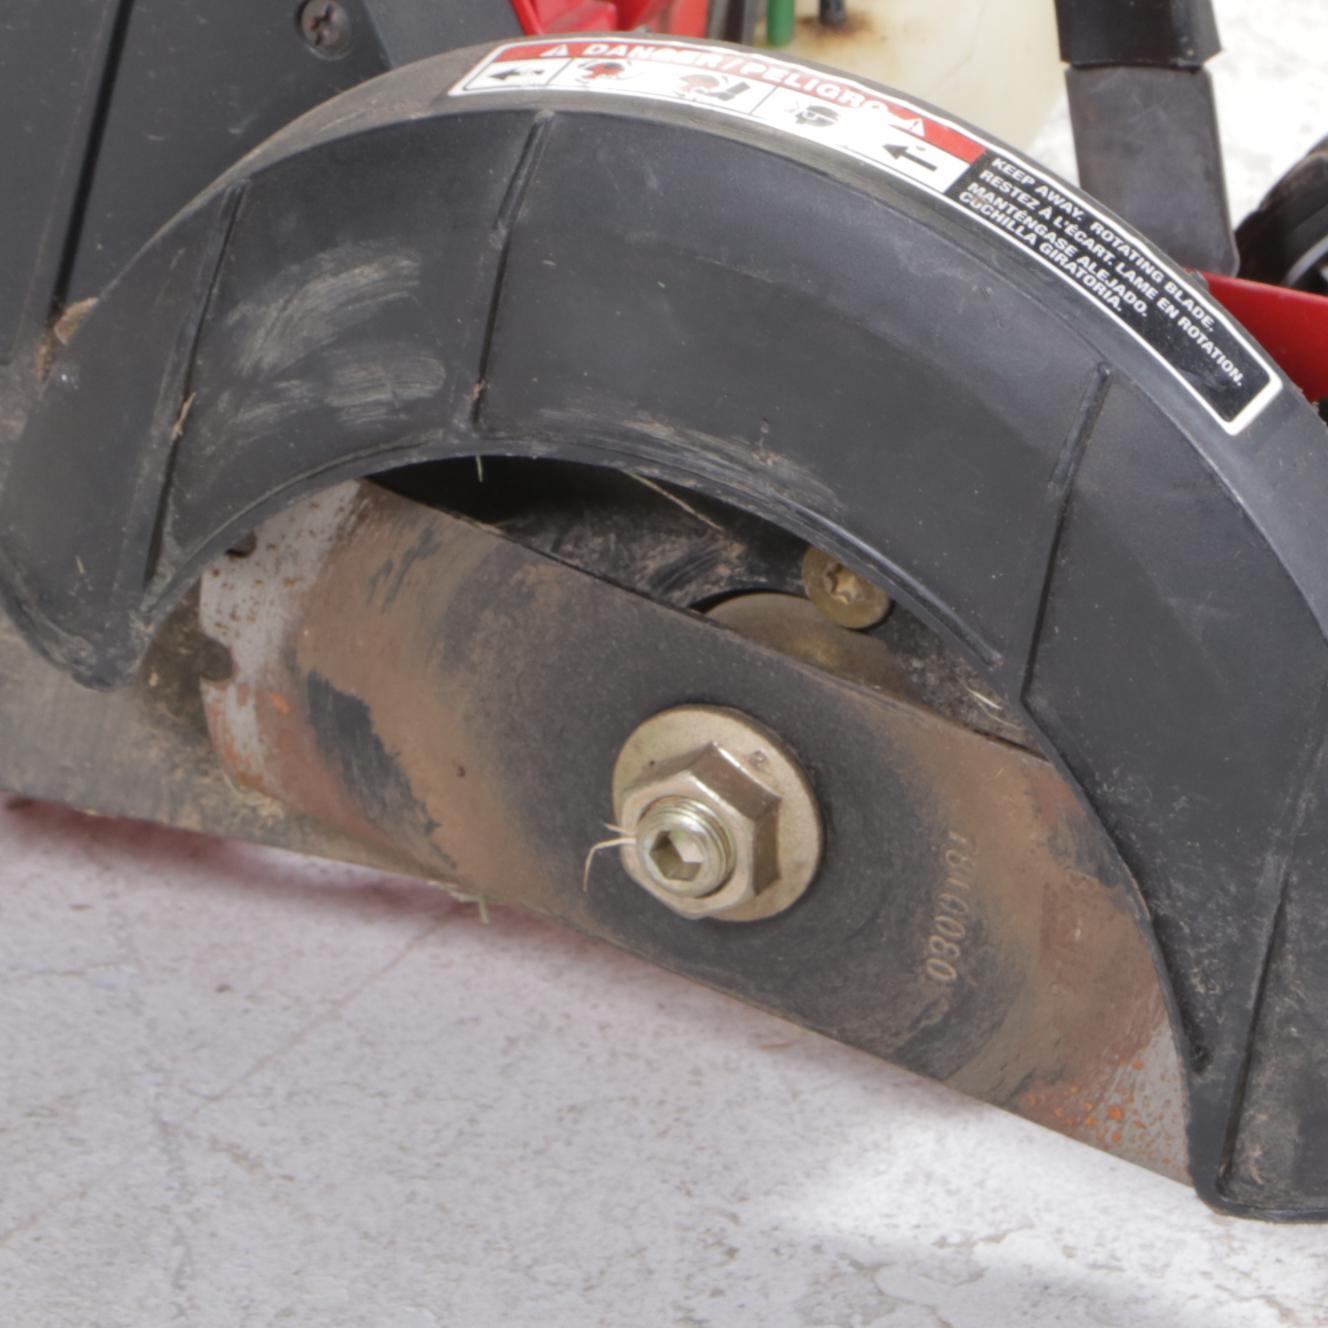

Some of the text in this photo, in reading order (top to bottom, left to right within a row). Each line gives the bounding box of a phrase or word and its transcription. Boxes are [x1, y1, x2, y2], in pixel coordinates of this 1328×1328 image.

[980, 170, 1040, 210] RESTEZ
[1116, 262, 1158, 300] LAME
[1156, 297, 1180, 319] EN
[1178, 316, 1243, 386] ROTATION.
[992, 158, 1215, 332] KEEP AWAY. ROTATING BLADE.
[1039, 242, 1122, 311] GIRATORIA.
[1077, 256, 1148, 317] ALEJADO.
